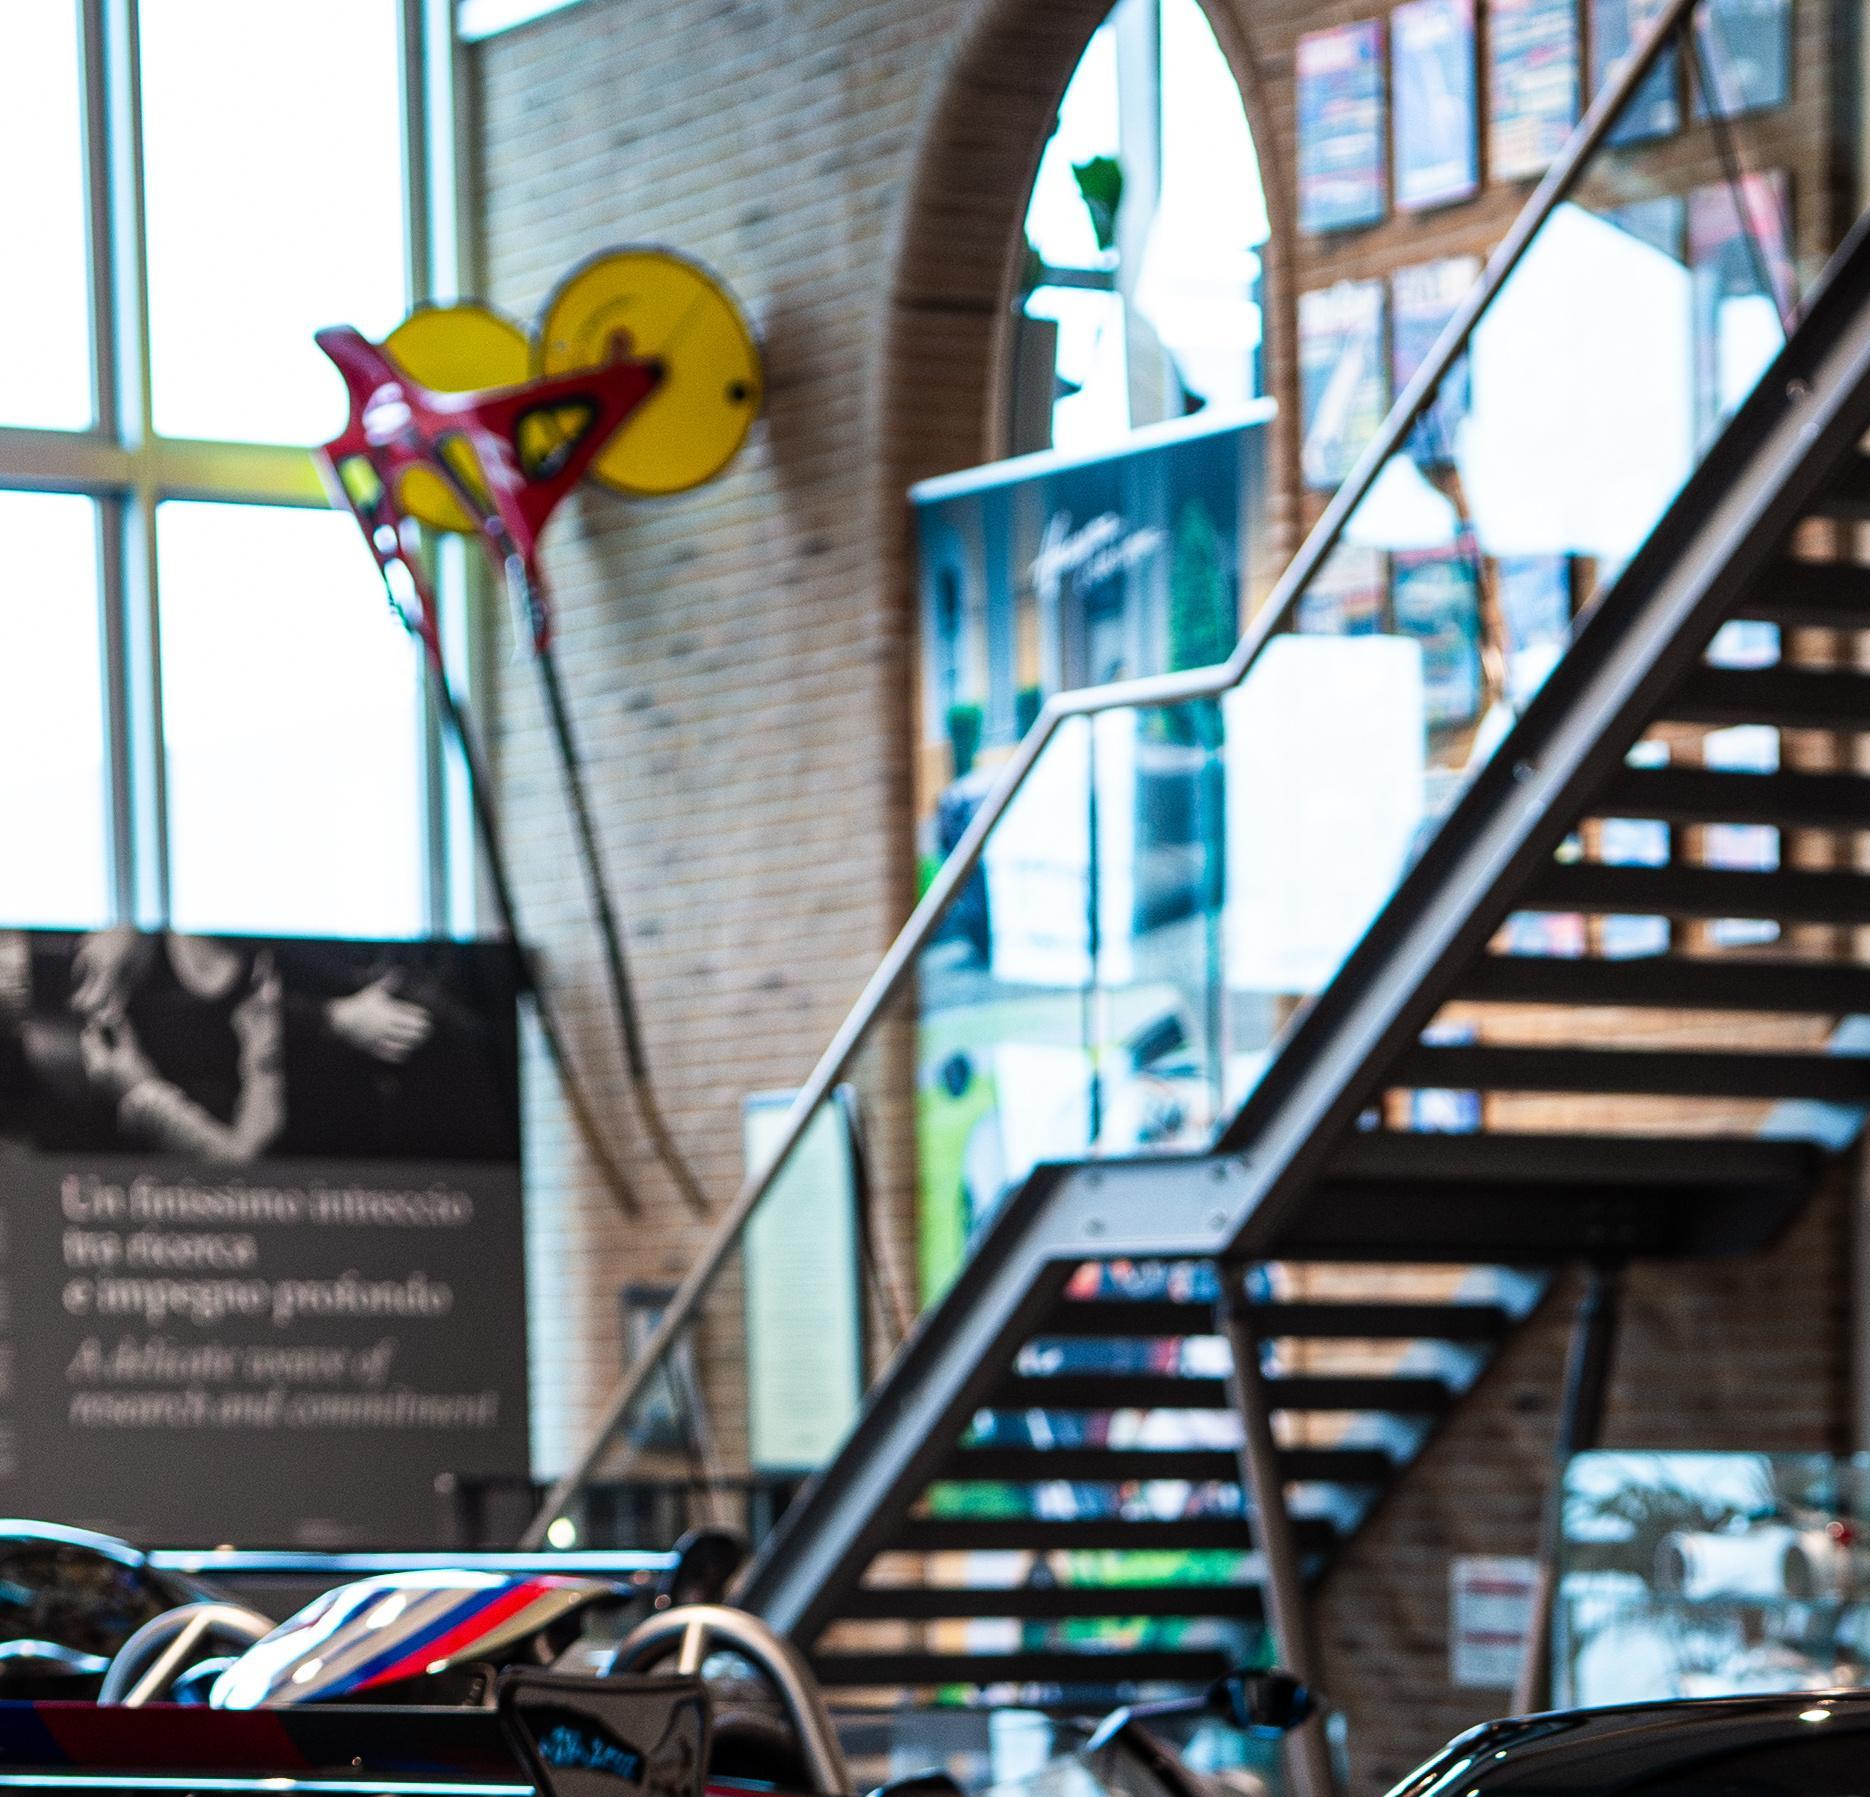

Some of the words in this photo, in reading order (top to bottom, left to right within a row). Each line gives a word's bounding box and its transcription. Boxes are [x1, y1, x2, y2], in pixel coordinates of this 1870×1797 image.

[62, 1174, 126, 1221] Un
[130, 1177, 307, 1223] finissimo
[310, 1180, 472, 1225] intreccio
[63, 1227, 123, 1268] tra
[127, 1227, 257, 1268] ricerca
[63, 1278, 95, 1315] e
[98, 1274, 270, 1326] impegno
[273, 1271, 452, 1327] profondo
[67, 1338, 100, 1383] A
[106, 1337, 239, 1383] delicate
[352, 1338, 396, 1386] of
[69, 1387, 209, 1427] research
[212, 1385, 287, 1427] and
[286, 1387, 496, 1427] commitment
